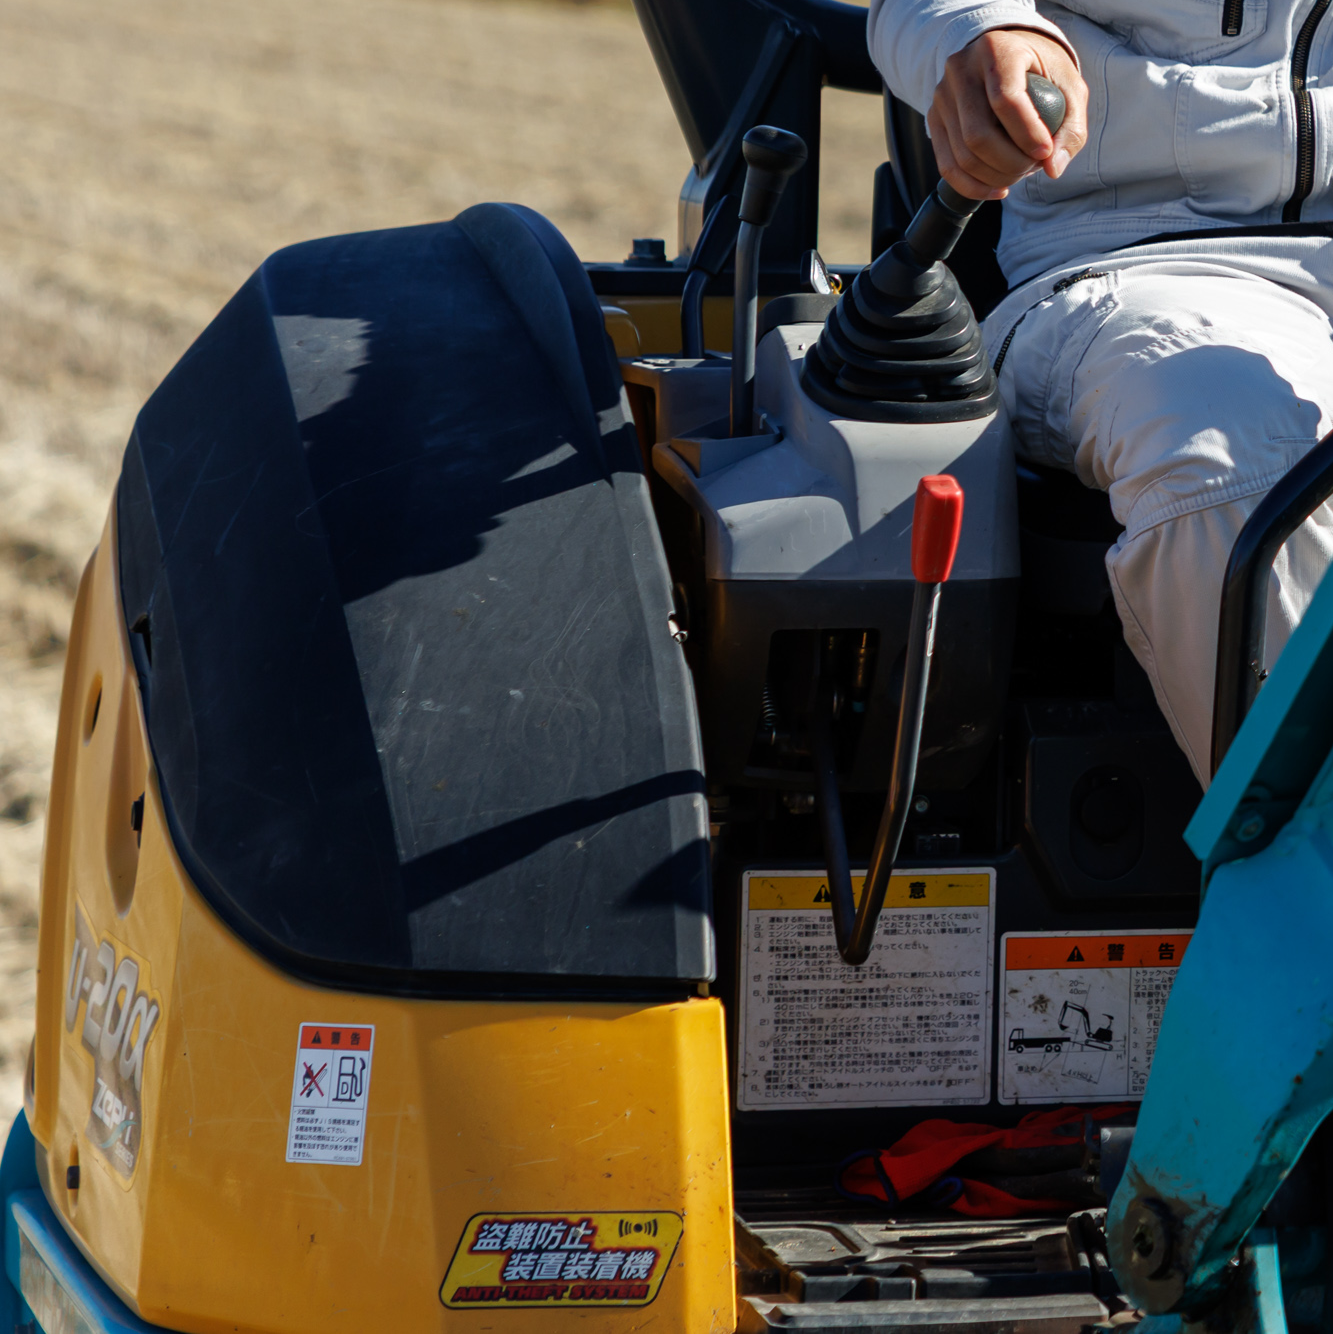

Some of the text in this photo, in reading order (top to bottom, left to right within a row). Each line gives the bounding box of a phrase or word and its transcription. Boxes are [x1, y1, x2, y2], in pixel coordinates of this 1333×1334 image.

[1107, 943, 1175, 962] 警告
[1134, 976, 1175, 984] ットホームを
[331, 1033, 361, 1046] 警告
[472, 1222, 593, 1251] 盗難防止
[502, 1250, 655, 1281] 装置装着機
[451, 1285, 650, 1302] ANTI-THEFT SYSTEM
